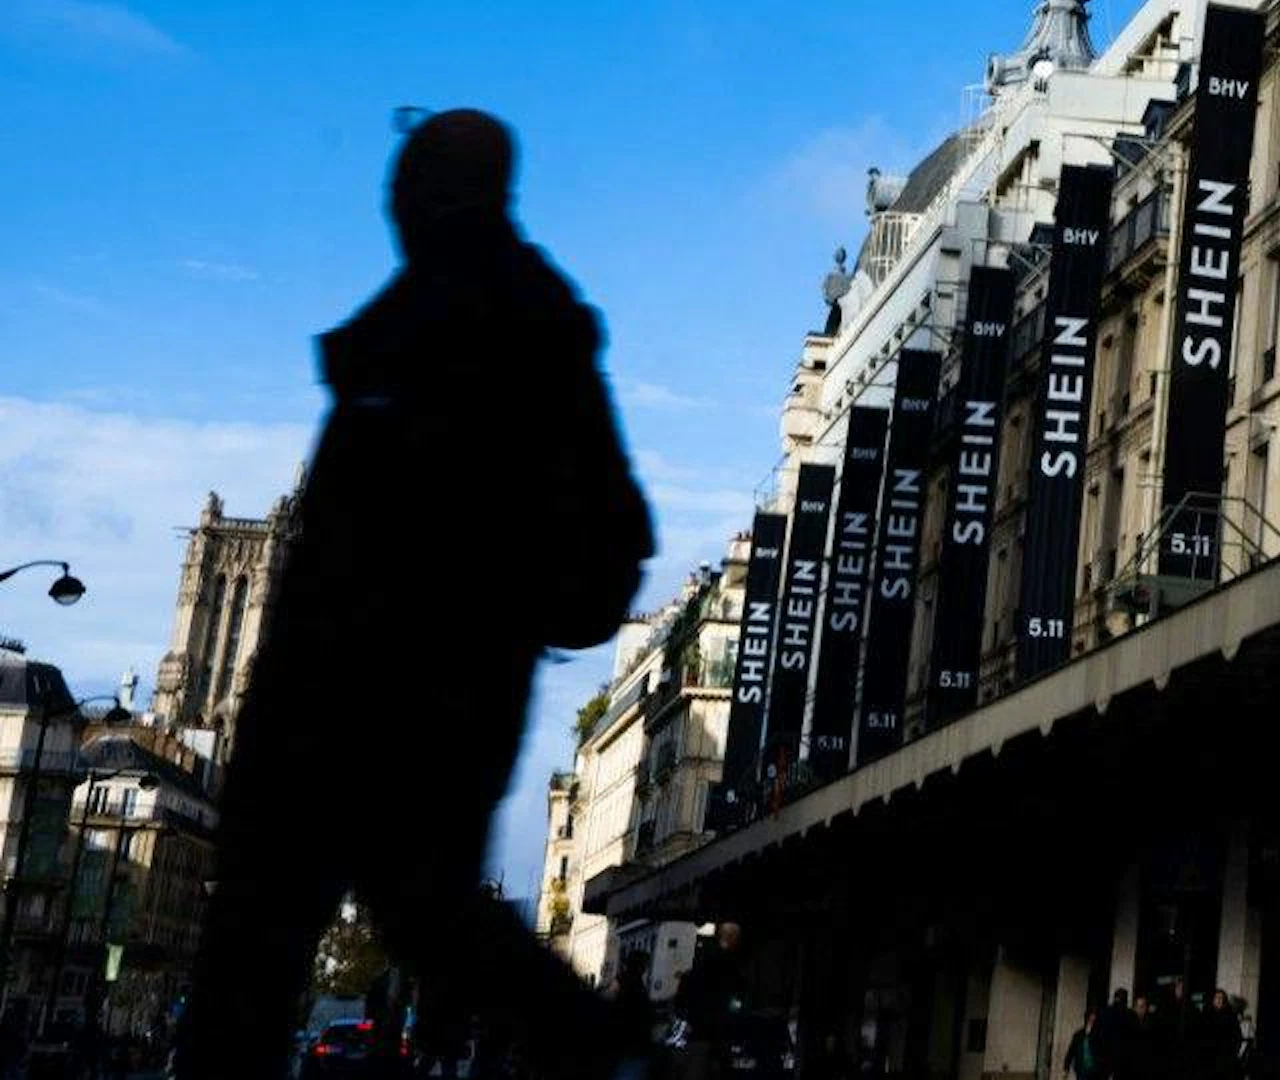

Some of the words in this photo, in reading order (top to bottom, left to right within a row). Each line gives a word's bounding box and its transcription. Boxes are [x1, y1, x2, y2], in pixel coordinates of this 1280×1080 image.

[1208, 76, 1249, 99] BHV
[1063, 227, 1099, 246] BHV
[1183, 178, 1235, 369] SHEIN
[973, 321, 1005, 338] BHV
[1040, 316, 1089, 478] SHEIN
[953, 400, 996, 545] SHEIN
[830, 511, 868, 632] SHEIN
[881, 468, 921, 600] SHEIN
[1170, 532, 1210, 557] 5.11
[737, 601, 772, 704] SHEIN
[781, 558, 818, 670] SHEIN
[1028, 617, 1064, 638] 5.11
[939, 670, 970, 688] 5.11
